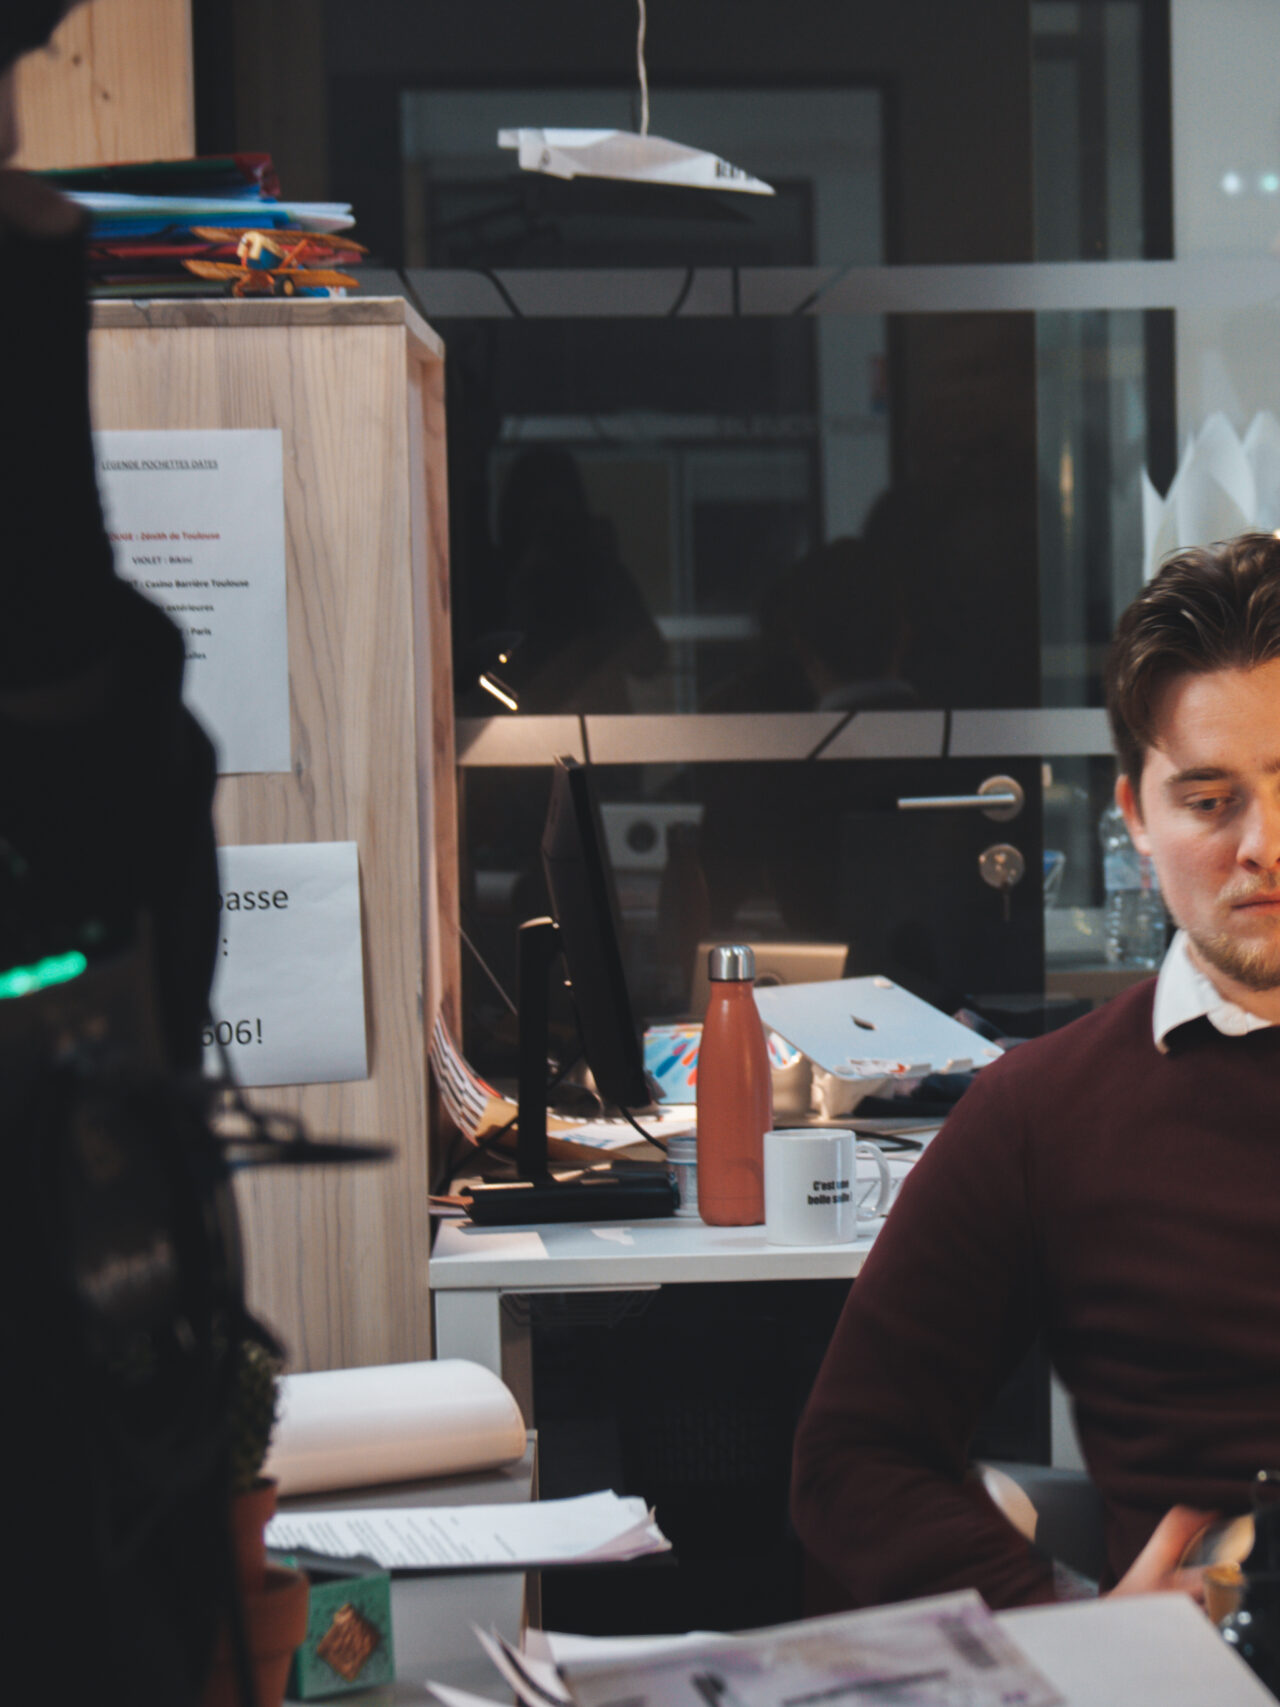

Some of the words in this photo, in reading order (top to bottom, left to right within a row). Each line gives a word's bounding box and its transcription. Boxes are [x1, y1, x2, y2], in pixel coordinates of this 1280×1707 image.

[141, 460, 189, 470] POCHETTES
[182, 532, 220, 540] Toulouse
[132, 556, 161, 565] VIOLET
[145, 580, 173, 588] Casino
[211, 578, 249, 588] Toulouse
[190, 627, 212, 636] Paris
[220, 889, 289, 911] asse
